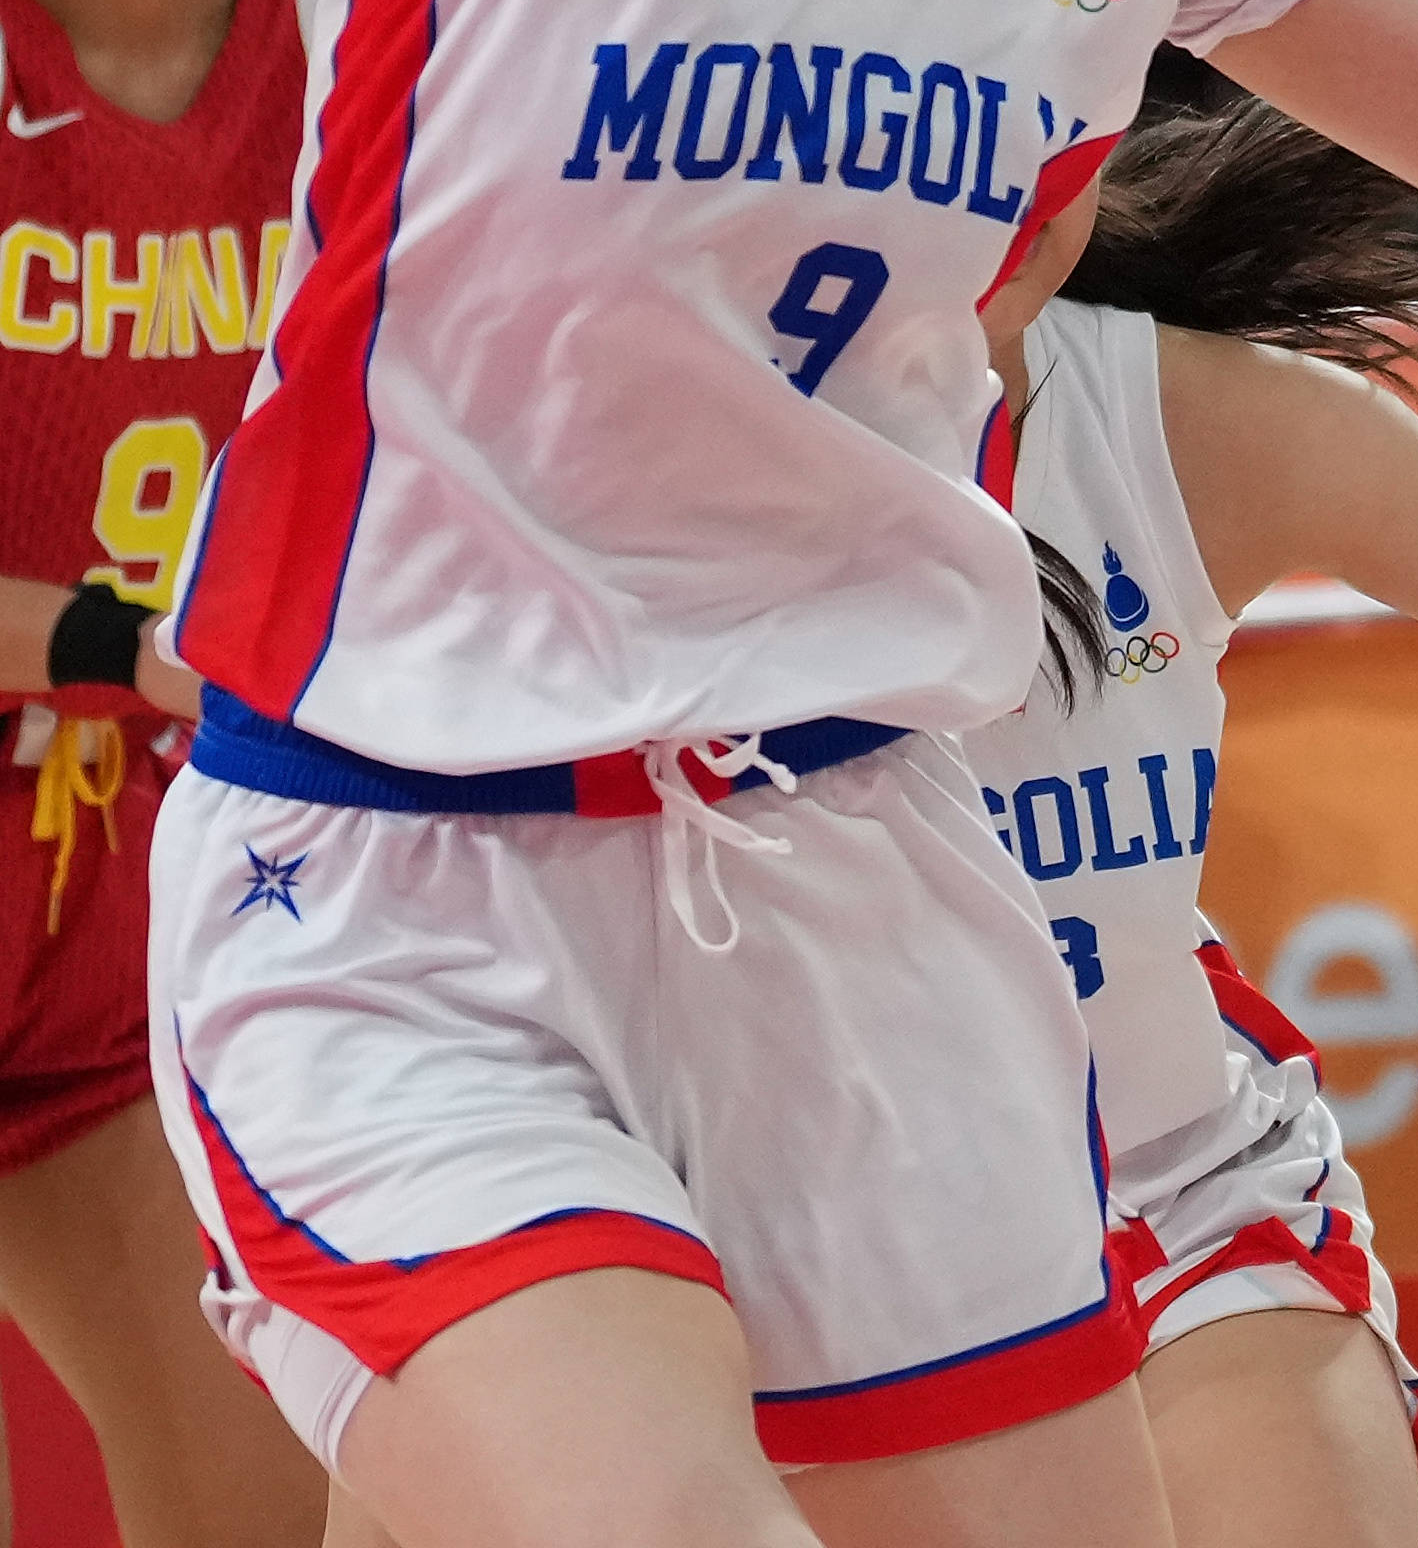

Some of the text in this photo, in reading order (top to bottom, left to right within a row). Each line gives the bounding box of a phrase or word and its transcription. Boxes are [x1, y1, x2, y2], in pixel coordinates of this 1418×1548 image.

[561, 42, 1088, 226] MONGOL
[768, 240, 890, 398] 9
[82, 417, 209, 612] 9
